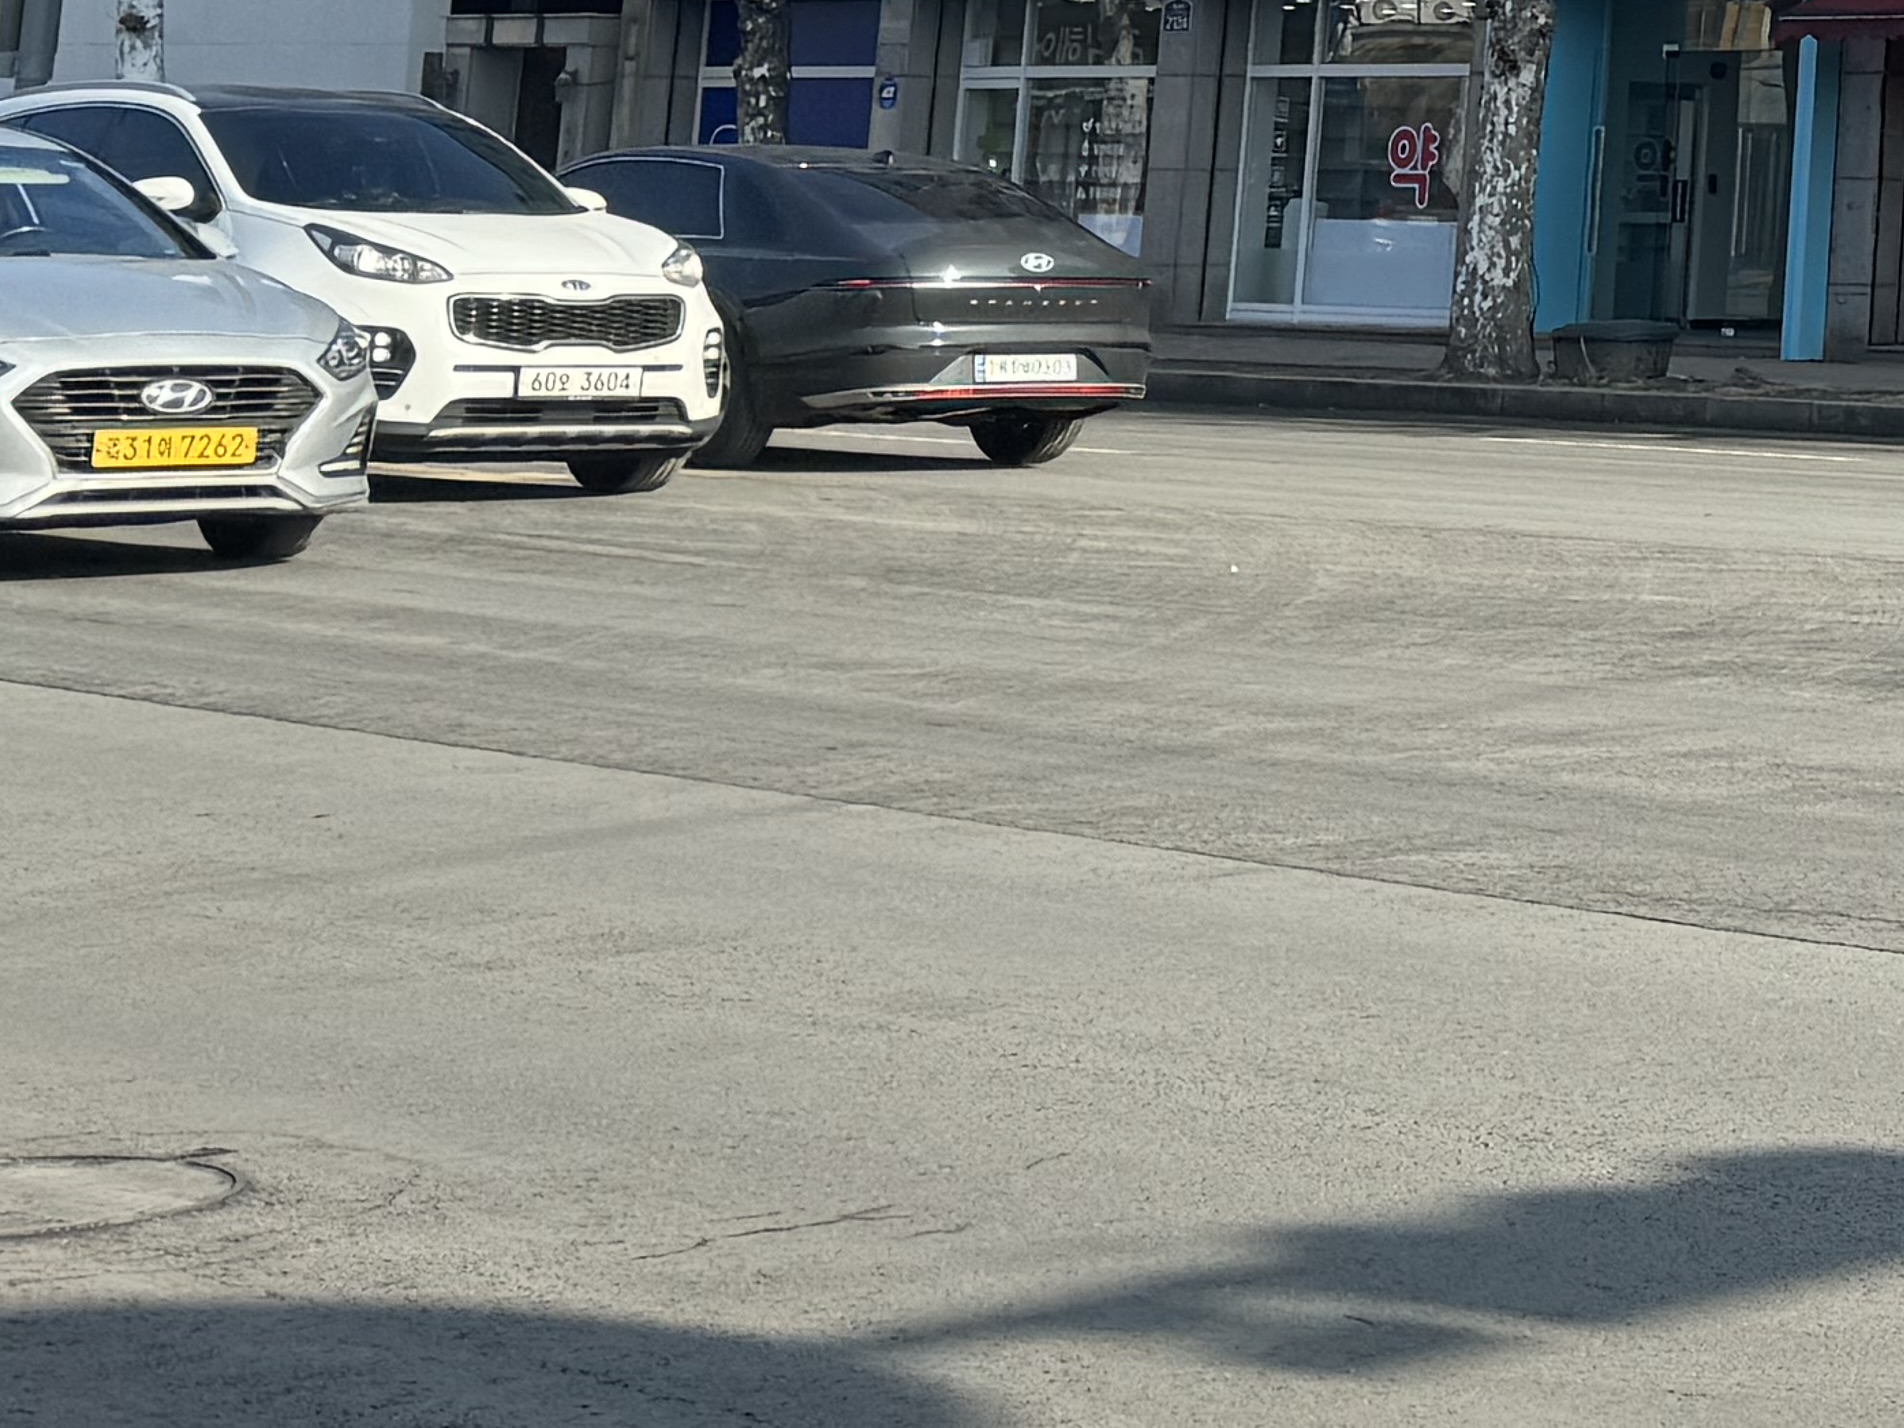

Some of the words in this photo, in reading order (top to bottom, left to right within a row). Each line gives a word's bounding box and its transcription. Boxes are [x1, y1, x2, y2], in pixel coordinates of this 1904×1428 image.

[1387, 122, 1441, 208] 약
[579, 371, 631, 393] 3604
[180, 433, 244, 459] 7262
